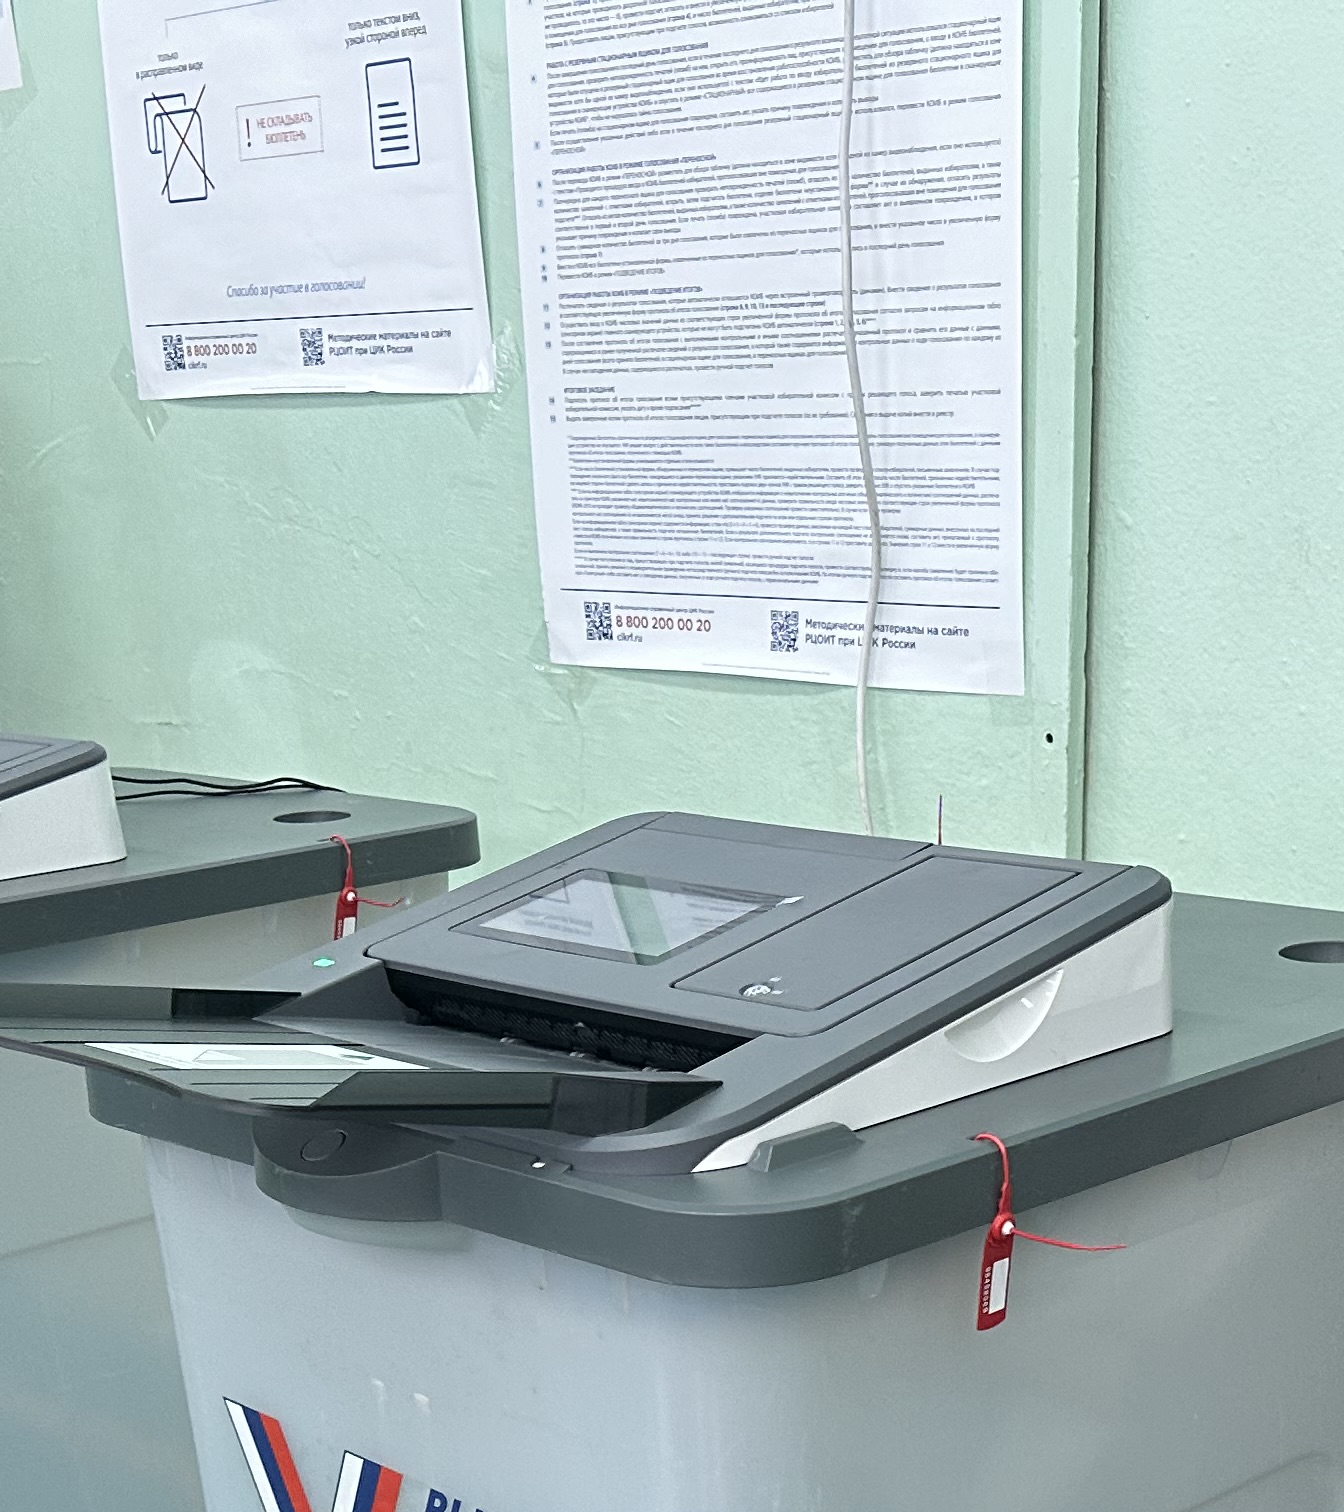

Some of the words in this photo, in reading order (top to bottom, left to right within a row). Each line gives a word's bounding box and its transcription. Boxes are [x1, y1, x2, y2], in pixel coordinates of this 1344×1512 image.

[213, 343, 230, 356] 200
[231, 343, 244, 355] 00
[246, 342, 257, 355] 20
[615, 615, 623, 628] 8
[625, 615, 649, 629] 800
[651, 616, 674, 631] 200
[676, 618, 694, 632] 00
[695, 619, 712, 633] 20
[805, 618, 865, 632] Методически
[927, 626, 939, 636] на
[941, 625, 970, 637] сайте
[805, 633, 836, 645] РЦОИТ
[838, 637, 855, 647] при
[881, 636, 916, 649] России
